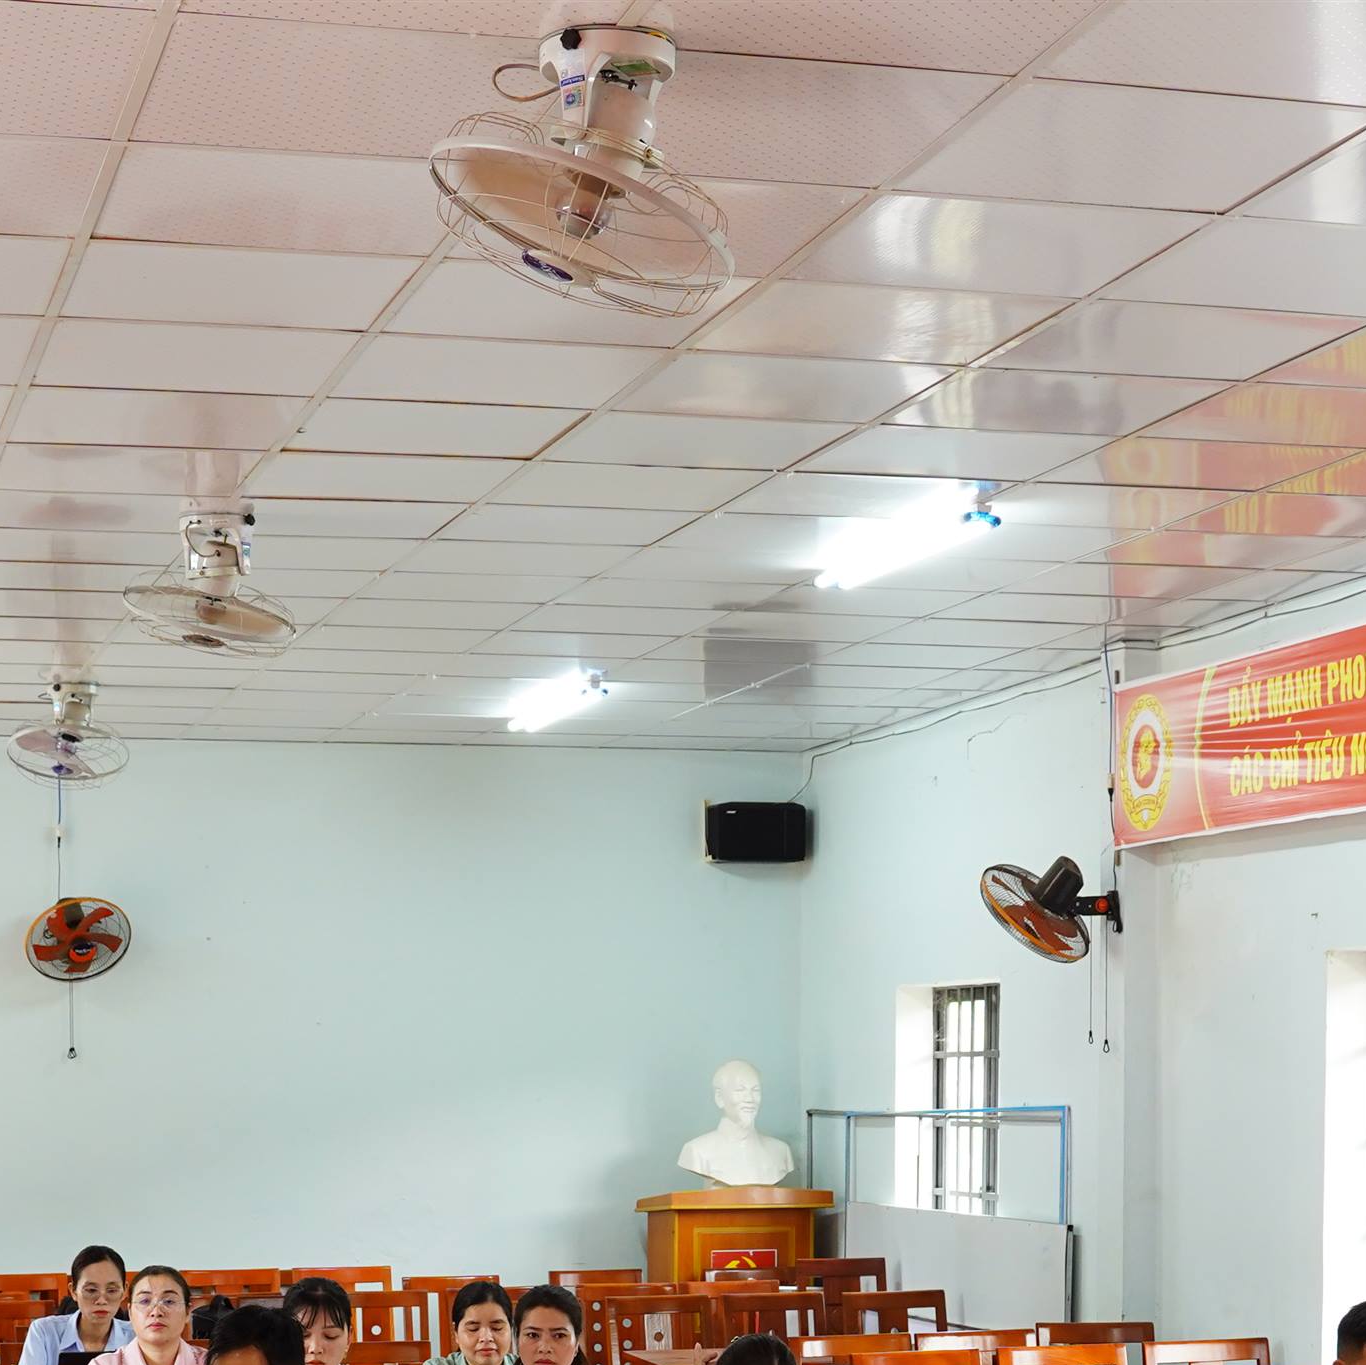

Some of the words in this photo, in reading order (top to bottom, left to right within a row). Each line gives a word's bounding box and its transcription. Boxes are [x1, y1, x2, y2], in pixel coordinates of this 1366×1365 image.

[1228, 665, 1262, 727] ĐẨY
[1266, 665, 1323, 724] MẠNH
[1229, 745, 1264, 797] CÁC
[1269, 729, 1301, 790] CHỈ
[1303, 728, 1347, 784] TIÊU
